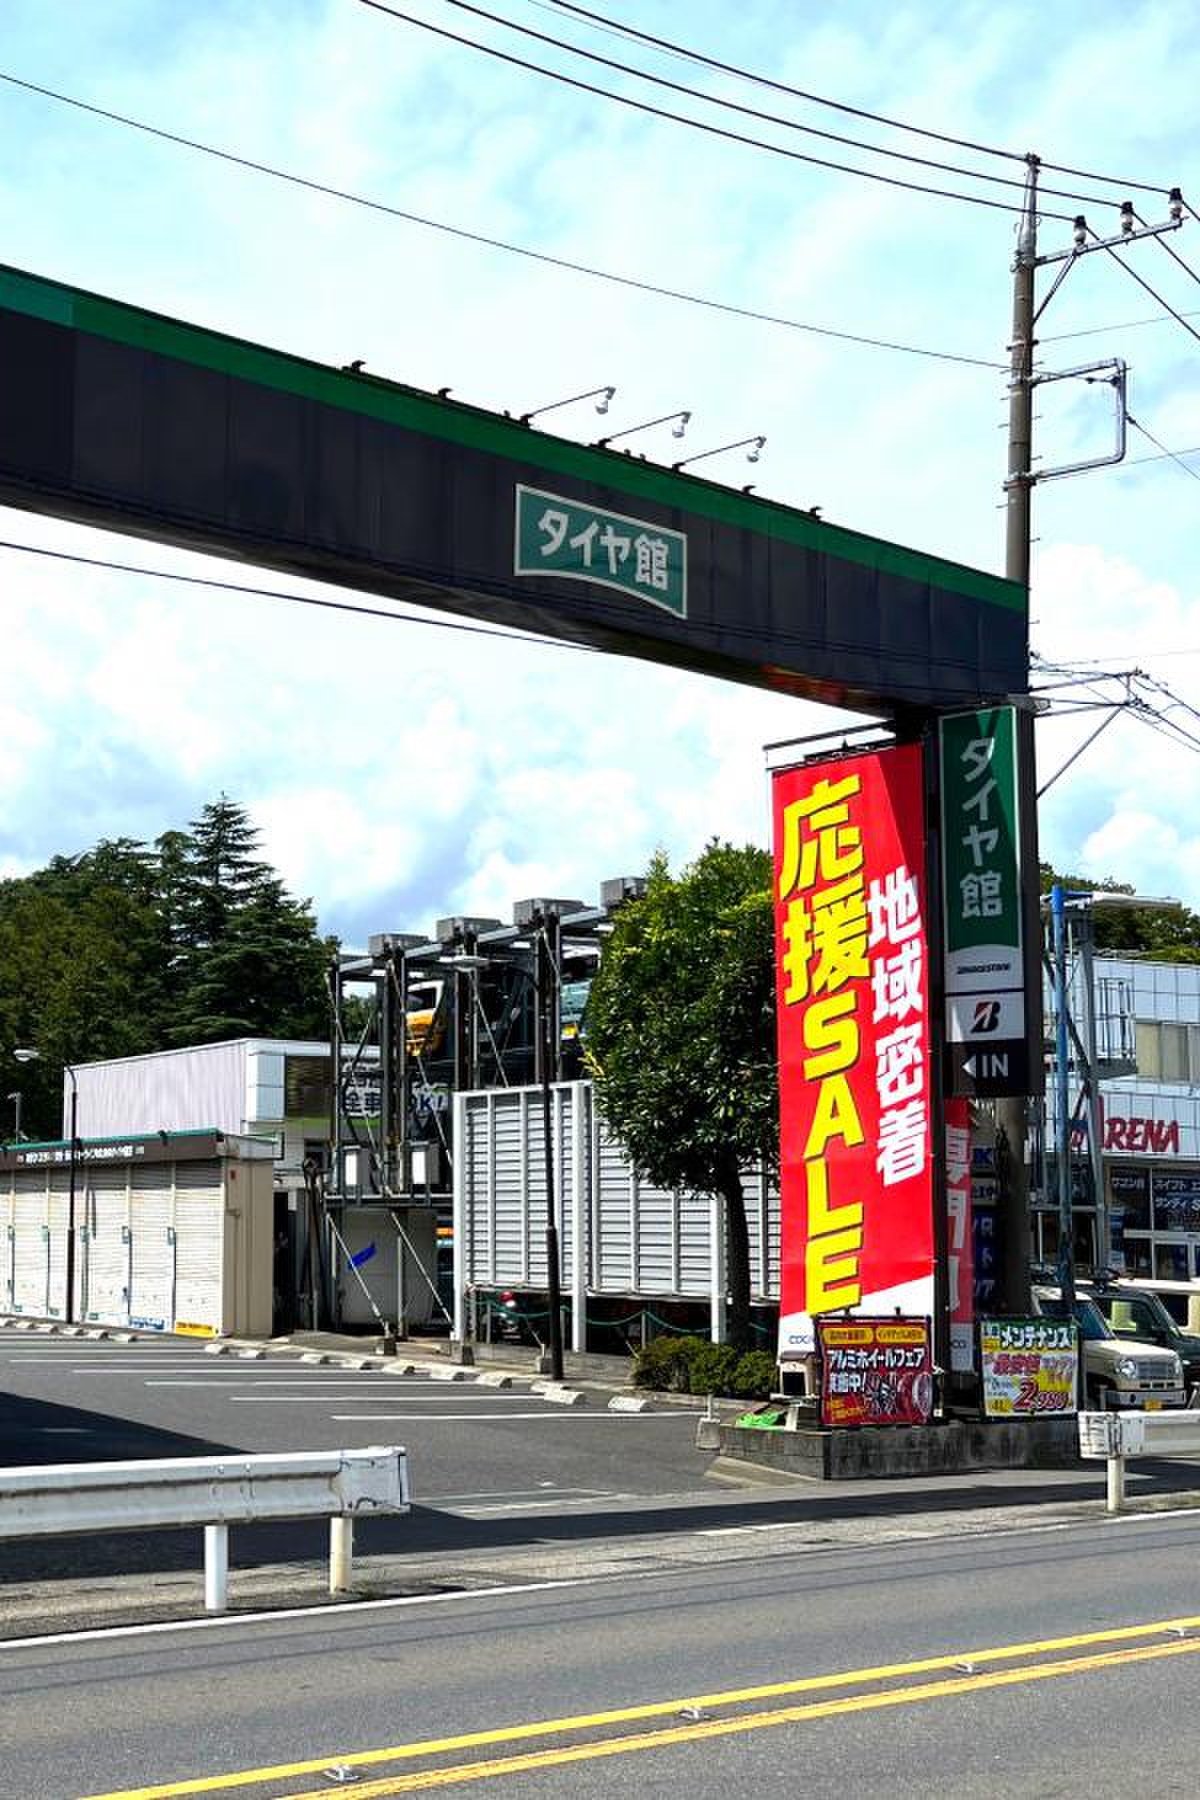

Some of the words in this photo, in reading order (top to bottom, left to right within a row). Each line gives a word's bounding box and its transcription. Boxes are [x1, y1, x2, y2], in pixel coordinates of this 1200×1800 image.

[537, 509, 670, 591] タイヤ館
[960, 736, 1004, 920] タイヤ館
[778, 774, 872, 1318] 応援SALE
[866, 865, 927, 1187] 地域密着
[982, 1053, 1009, 1077] IN
[827, 1348, 926, 1370] アルミホイールフェア
[1001, 1325, 1072, 1349] メンテナンス
